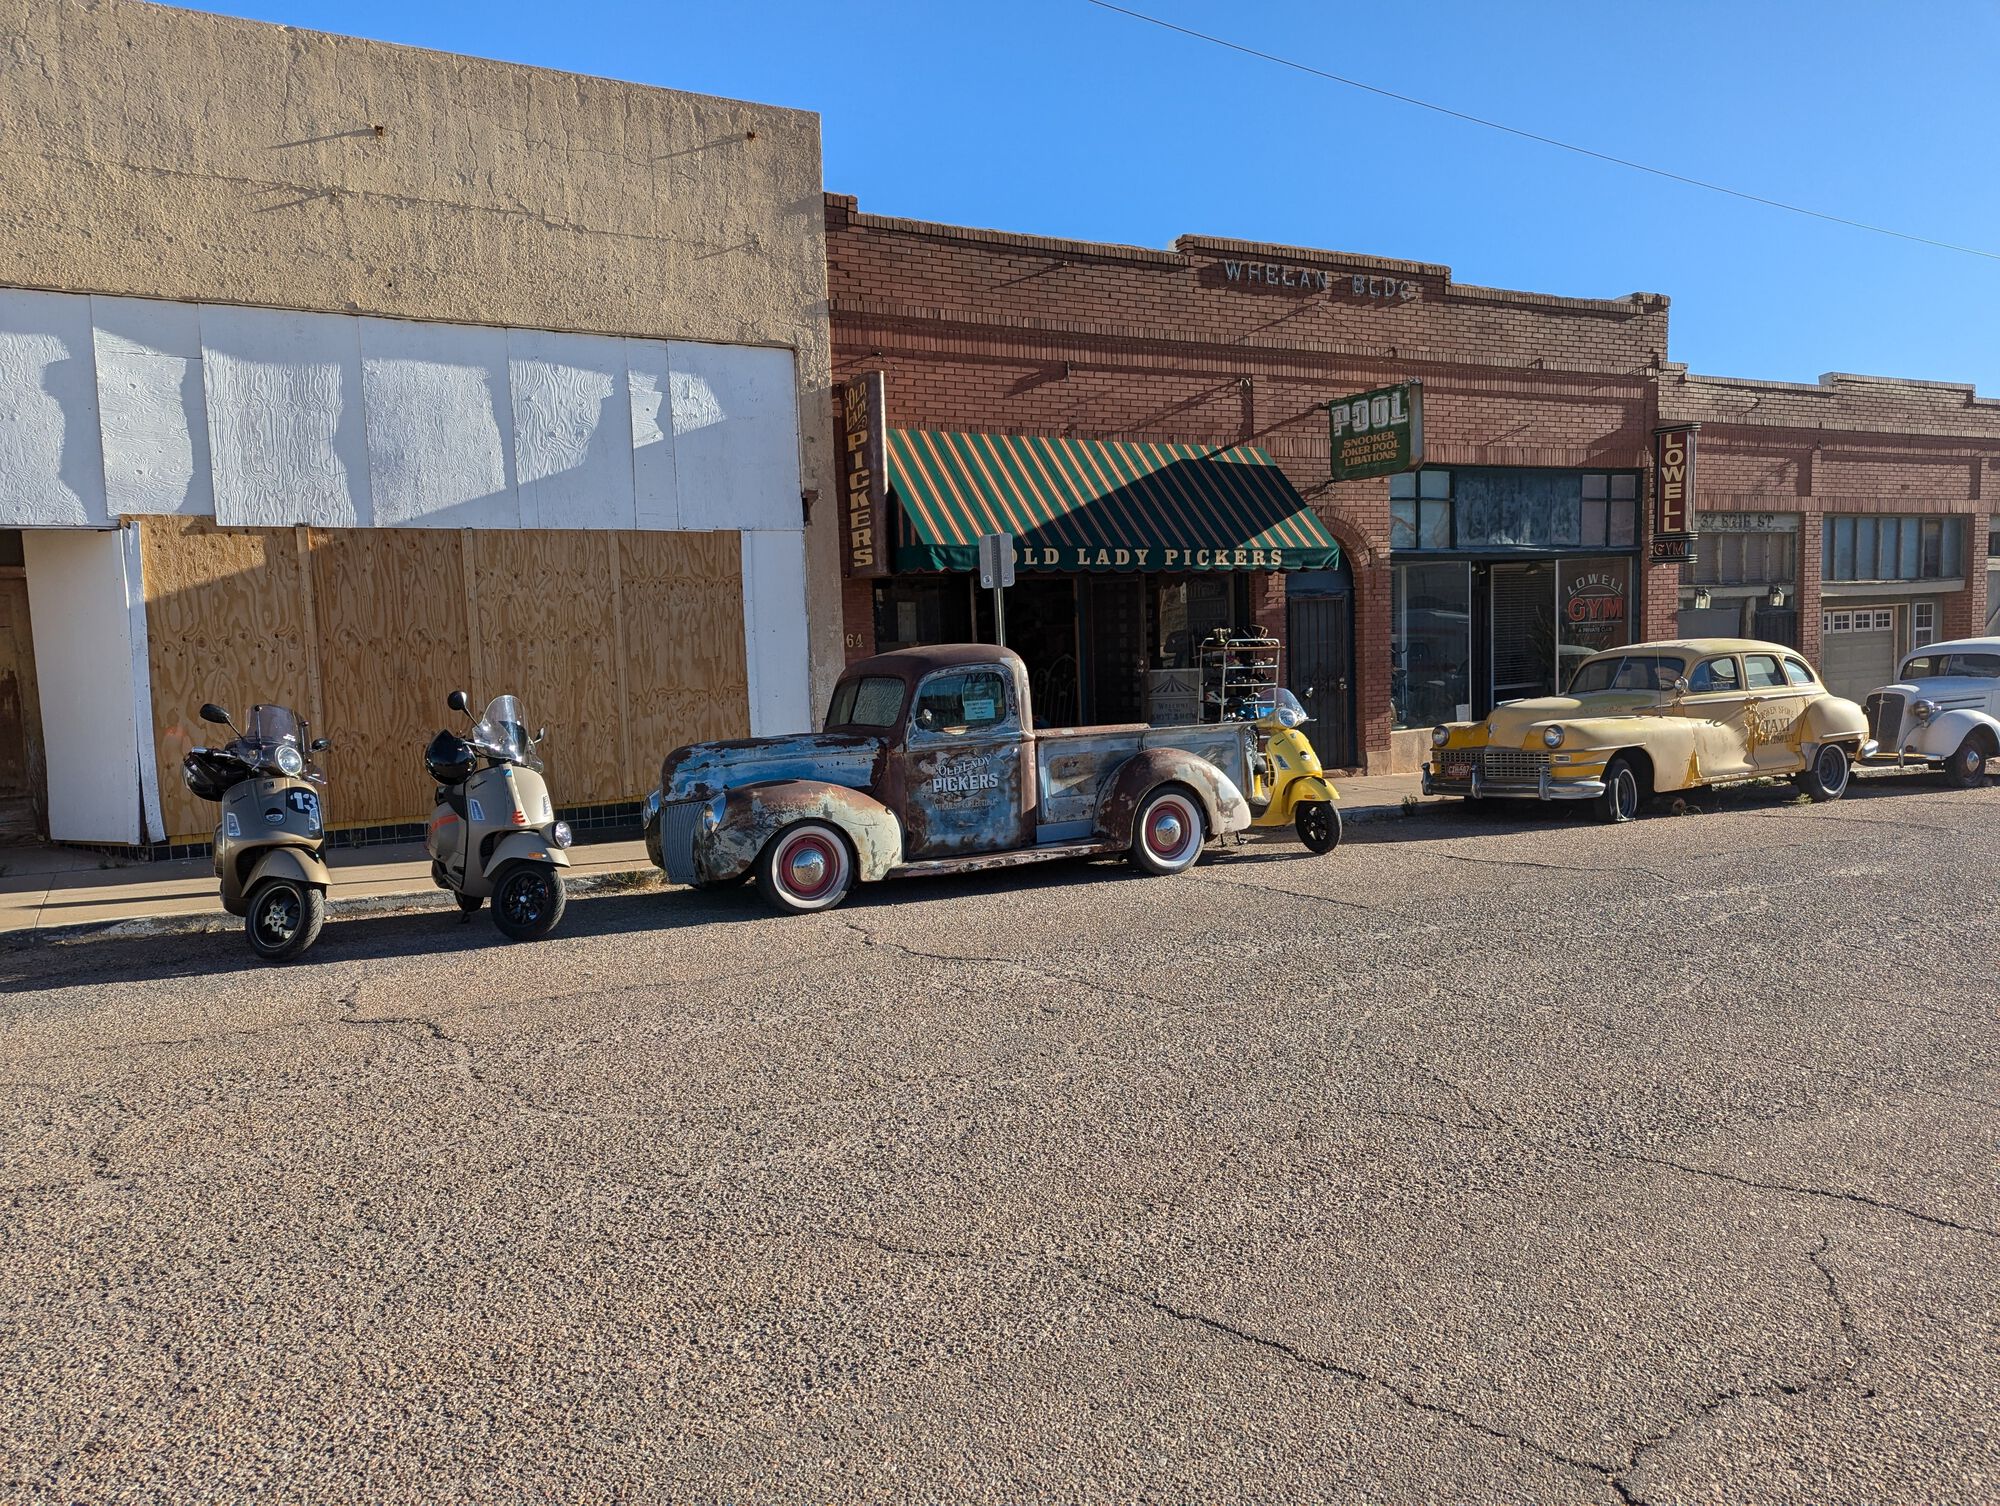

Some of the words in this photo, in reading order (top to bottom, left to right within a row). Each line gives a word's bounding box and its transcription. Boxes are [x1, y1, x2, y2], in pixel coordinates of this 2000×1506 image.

[1222, 259, 1329, 291] WHELAN
[845, 382, 867, 409] OLD
[846, 400, 868, 432] LADY
[1331, 391, 1408, 437] POOL
[1340, 445, 1371, 459] JOKER
[1372, 439, 1400, 452] POOL
[1343, 430, 1395, 449] SNOOKER
[1345, 449, 1397, 466] LIBATIONS
[1661, 433, 1685, 533] LOWELL
[847, 429, 874, 568] PICKERS
[1700, 513, 1716, 528] 37
[1757, 513, 1774, 528] ST
[1077, 548, 1150, 565] LADY
[1165, 549, 1282, 566] PICKERS
[1654, 542, 1685, 556] GYM
[1567, 573, 1623, 595] LOWELL
[1568, 597, 1624, 621] GYM
[846, 633, 863, 648] 64
[1763, 717, 1790, 734] TAXI
[937, 764, 961, 776] OLD
[962, 753, 992, 772] LADY
[932, 773, 999, 793] PICKERS
[290, 792, 318, 811] 13
